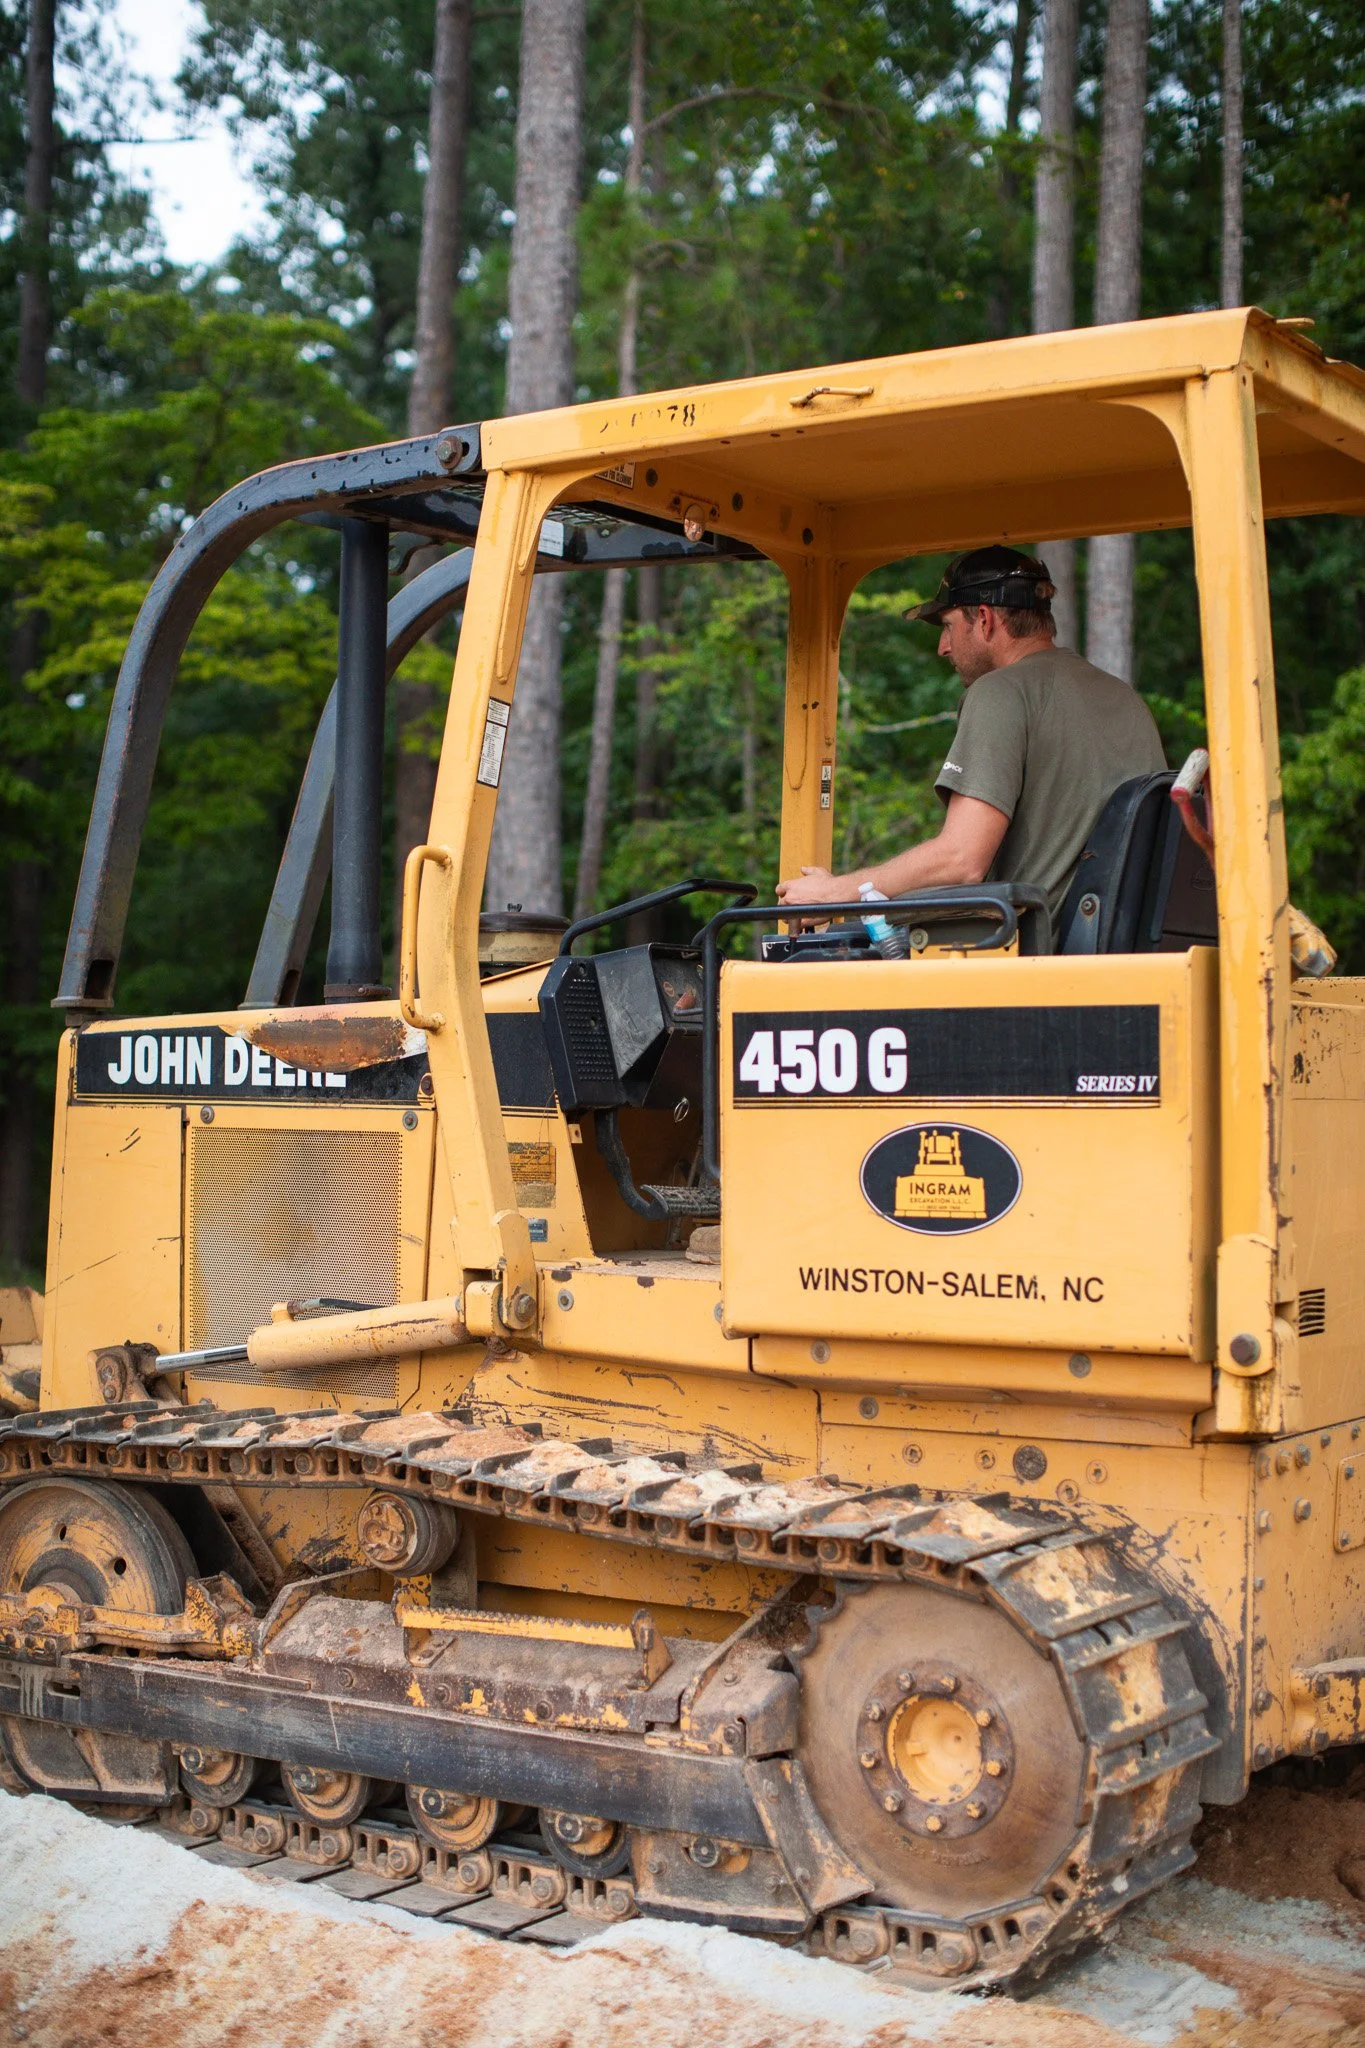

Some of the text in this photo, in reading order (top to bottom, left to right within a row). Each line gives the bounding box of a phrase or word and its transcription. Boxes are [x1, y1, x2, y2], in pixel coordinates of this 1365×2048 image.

[108, 1035, 212, 1085] JOHN
[740, 1027, 907, 1093] 450 G
[1076, 1075, 1158, 1092] SERIES IV
[909, 1182, 971, 1196] INGRAM
[799, 1266, 1104, 1304] WINSTON-SALEM, NC
